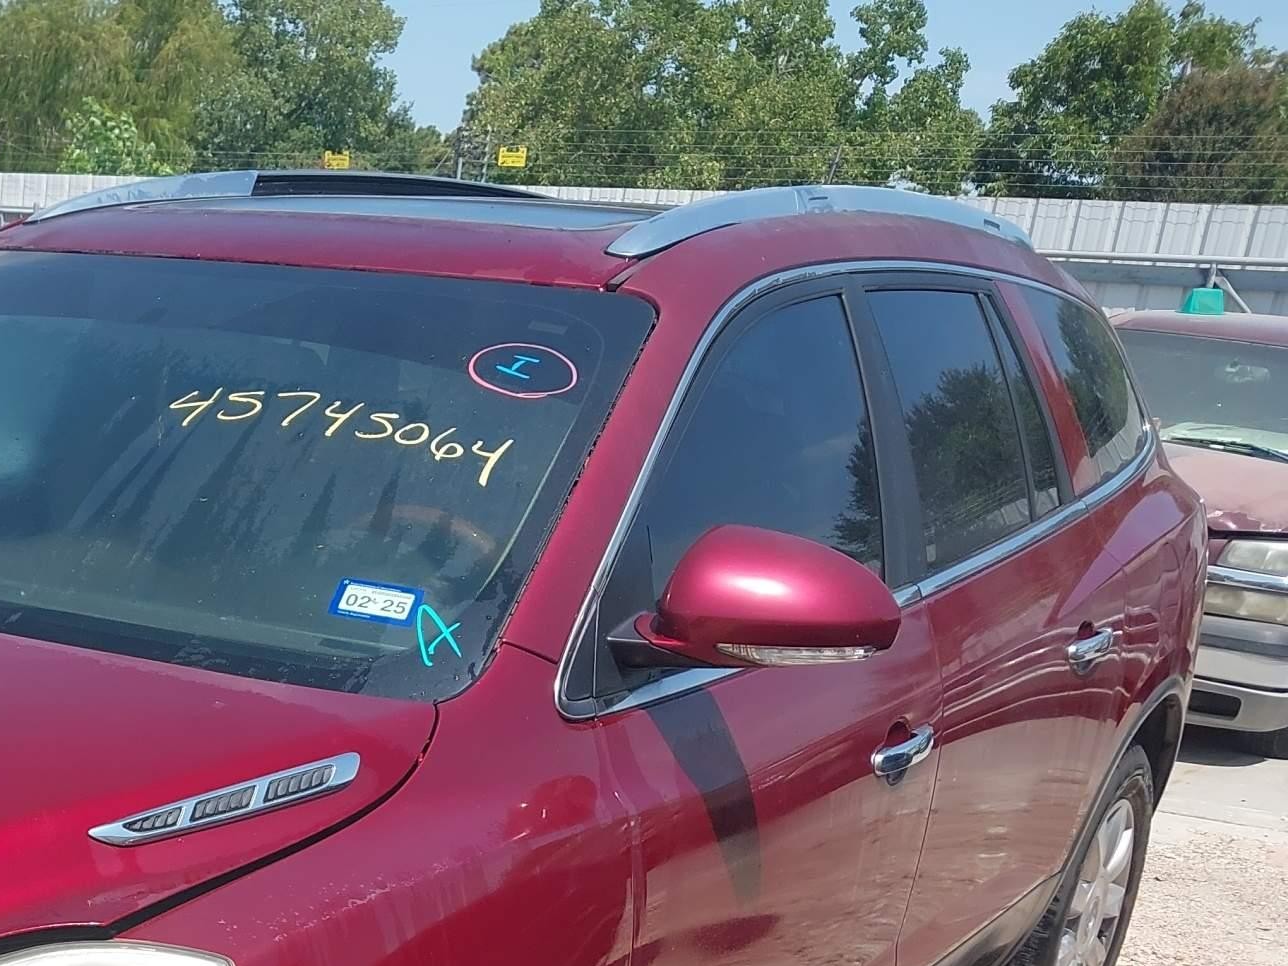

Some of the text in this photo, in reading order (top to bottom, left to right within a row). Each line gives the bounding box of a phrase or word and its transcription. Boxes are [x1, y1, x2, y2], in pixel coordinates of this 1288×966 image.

[169, 387, 514, 488] 45745064
[345, 593, 372, 609] 02
[380, 599, 408, 615] 25
[416, 604, 461, 667] A
